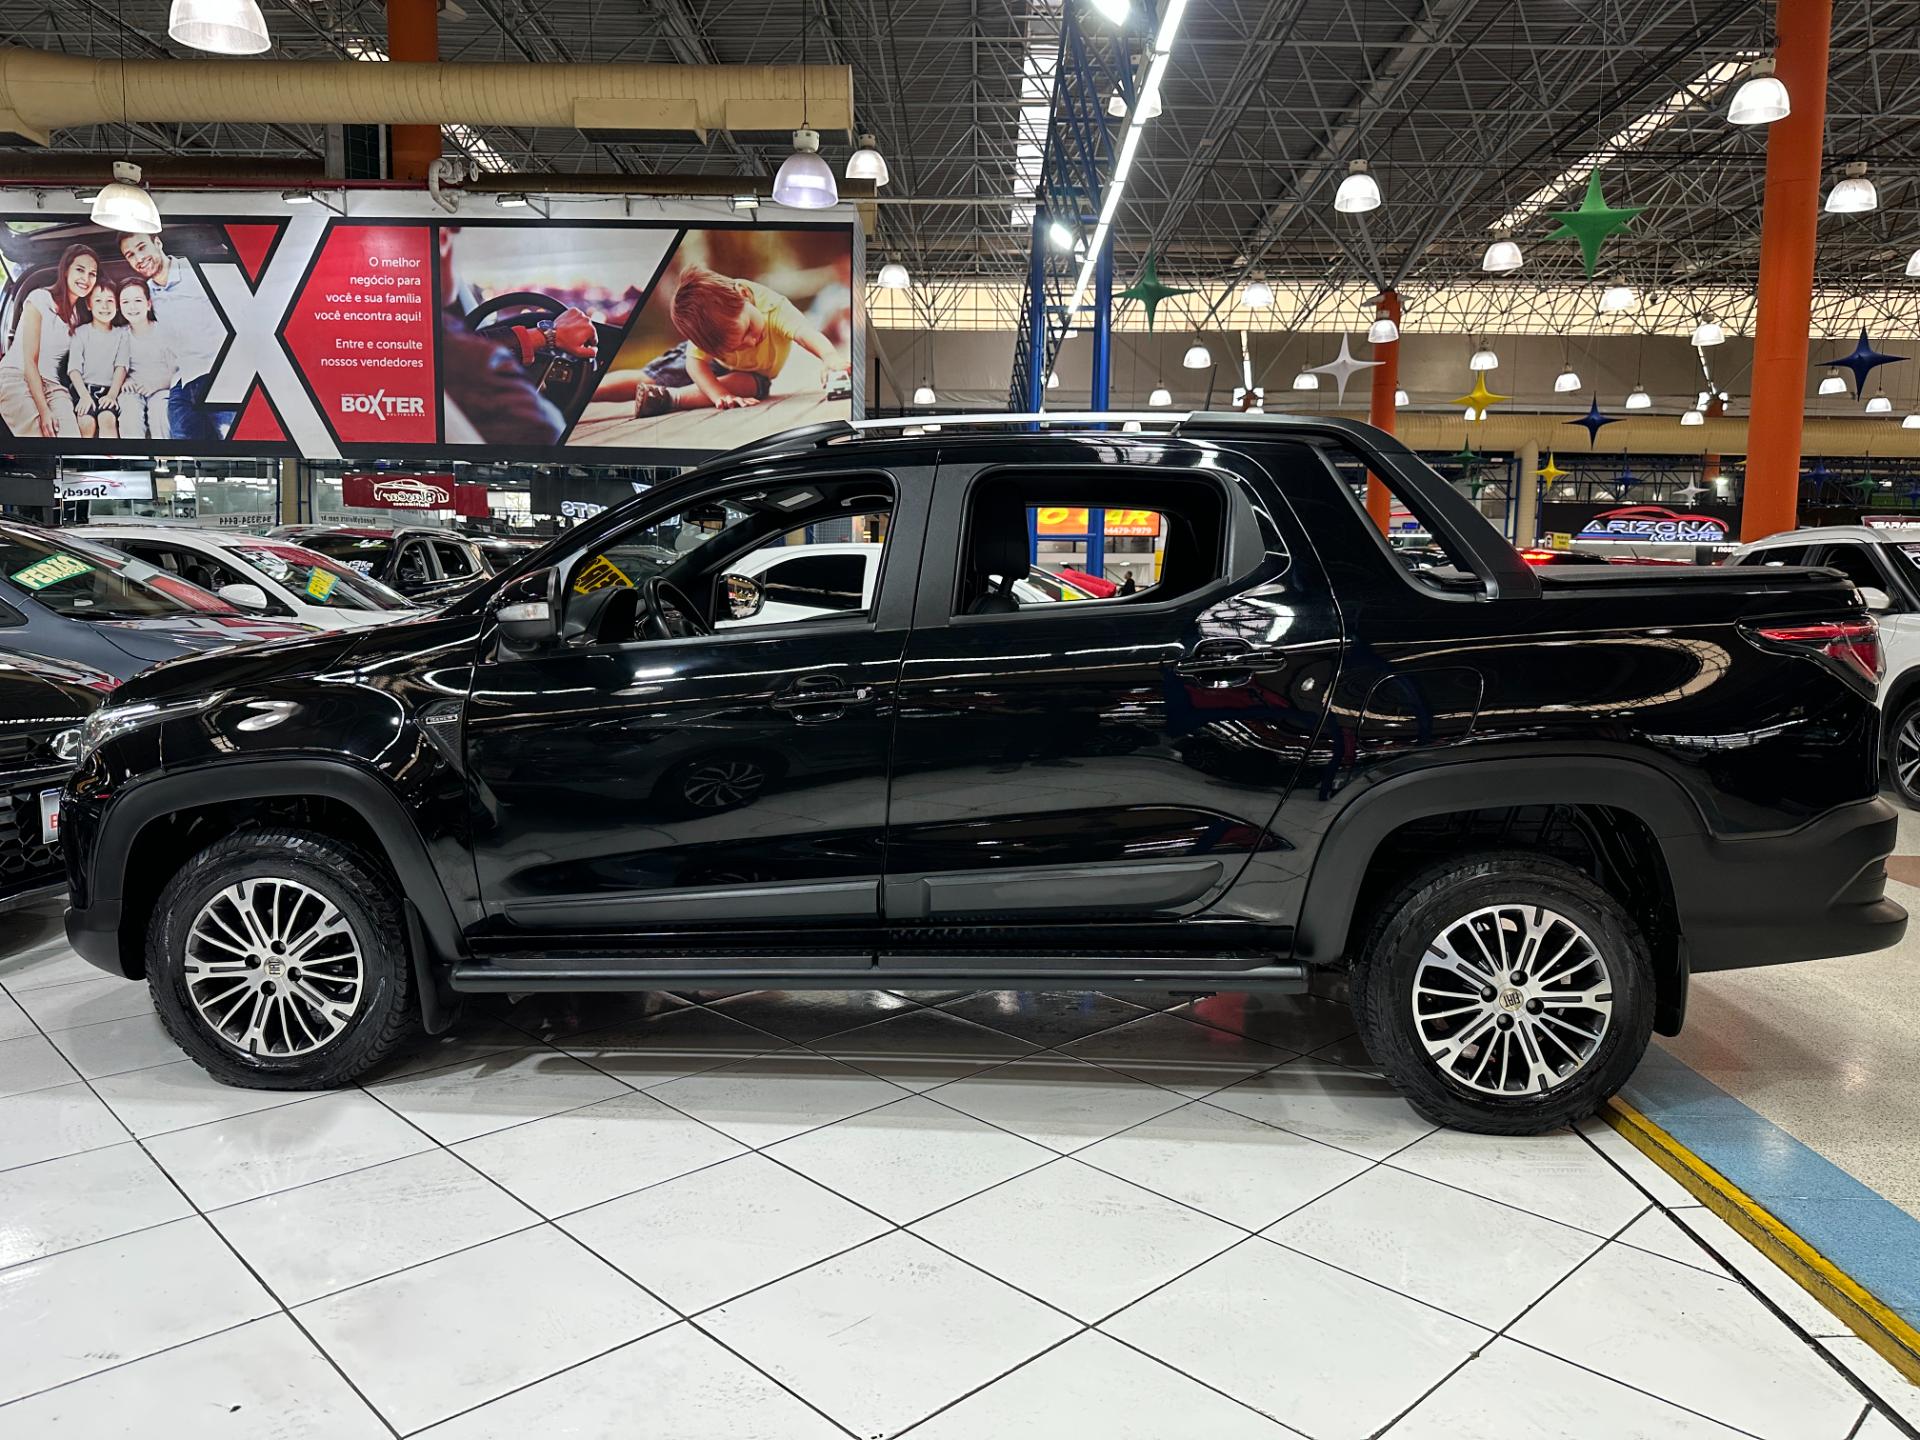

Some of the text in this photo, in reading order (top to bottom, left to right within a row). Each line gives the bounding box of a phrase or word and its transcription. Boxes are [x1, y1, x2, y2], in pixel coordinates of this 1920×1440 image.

[369, 256, 421, 268] O melhor
[349, 275, 421, 288] negócio para
[325, 293, 421, 304] você e sua família
[314, 310, 422, 323] você encontra aqui!
[335, 339, 423, 350] Entre e consulte
[320, 357, 424, 368] nossos vendedores
[341, 389, 425, 421] BOXTER
[1582, 520, 1723, 535] ARIZONA
[1649, 533, 1723, 541] MOTORS
[1503, 991, 1520, 1008] FIAT
